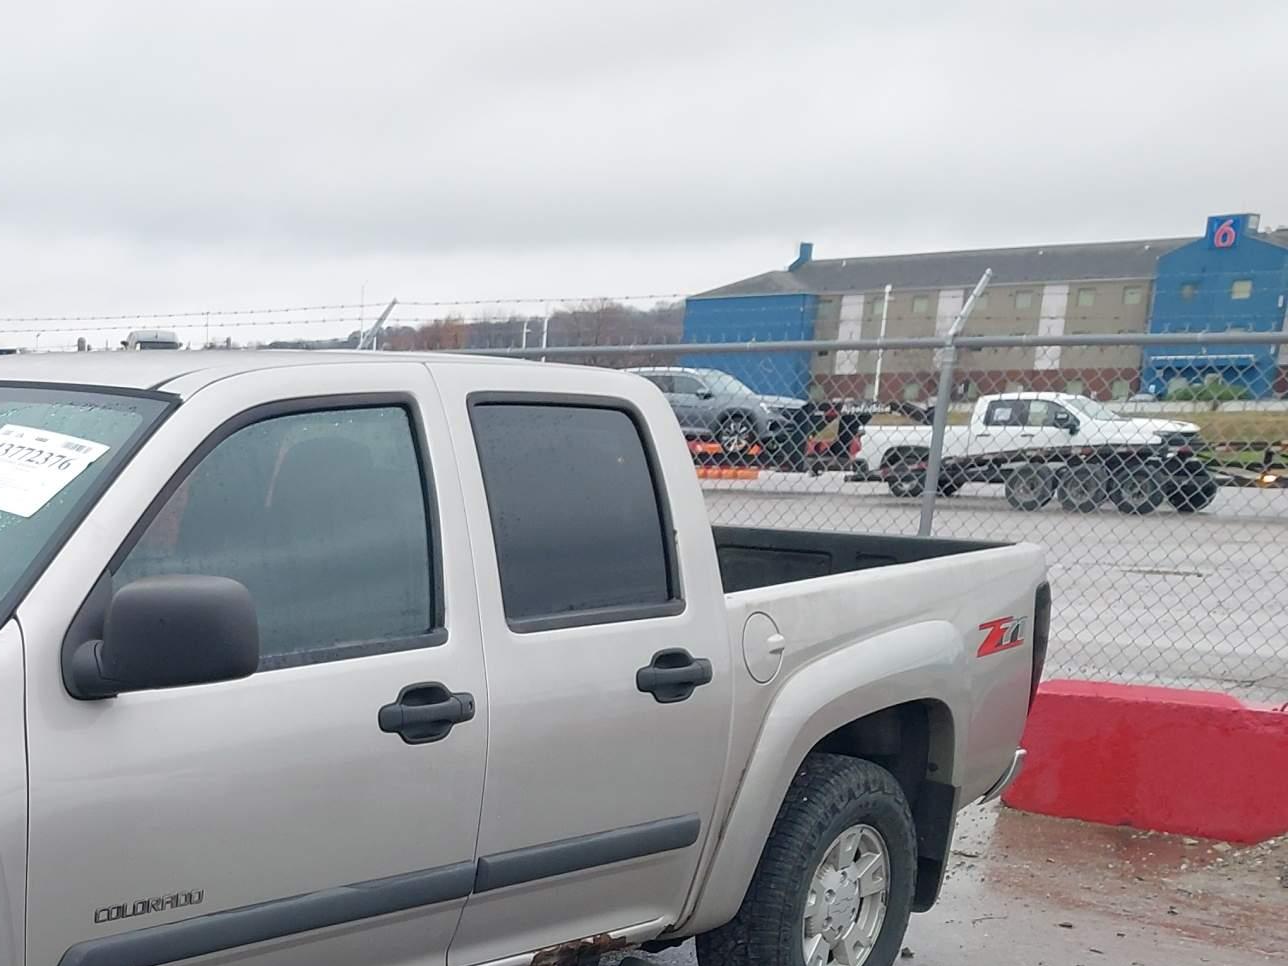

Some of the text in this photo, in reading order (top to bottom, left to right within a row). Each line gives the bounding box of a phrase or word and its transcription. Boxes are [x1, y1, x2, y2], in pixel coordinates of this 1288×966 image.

[1214, 219, 1236, 248] 6
[976, 615, 1028, 658] Z71
[94, 889, 205, 924] COLORADO
